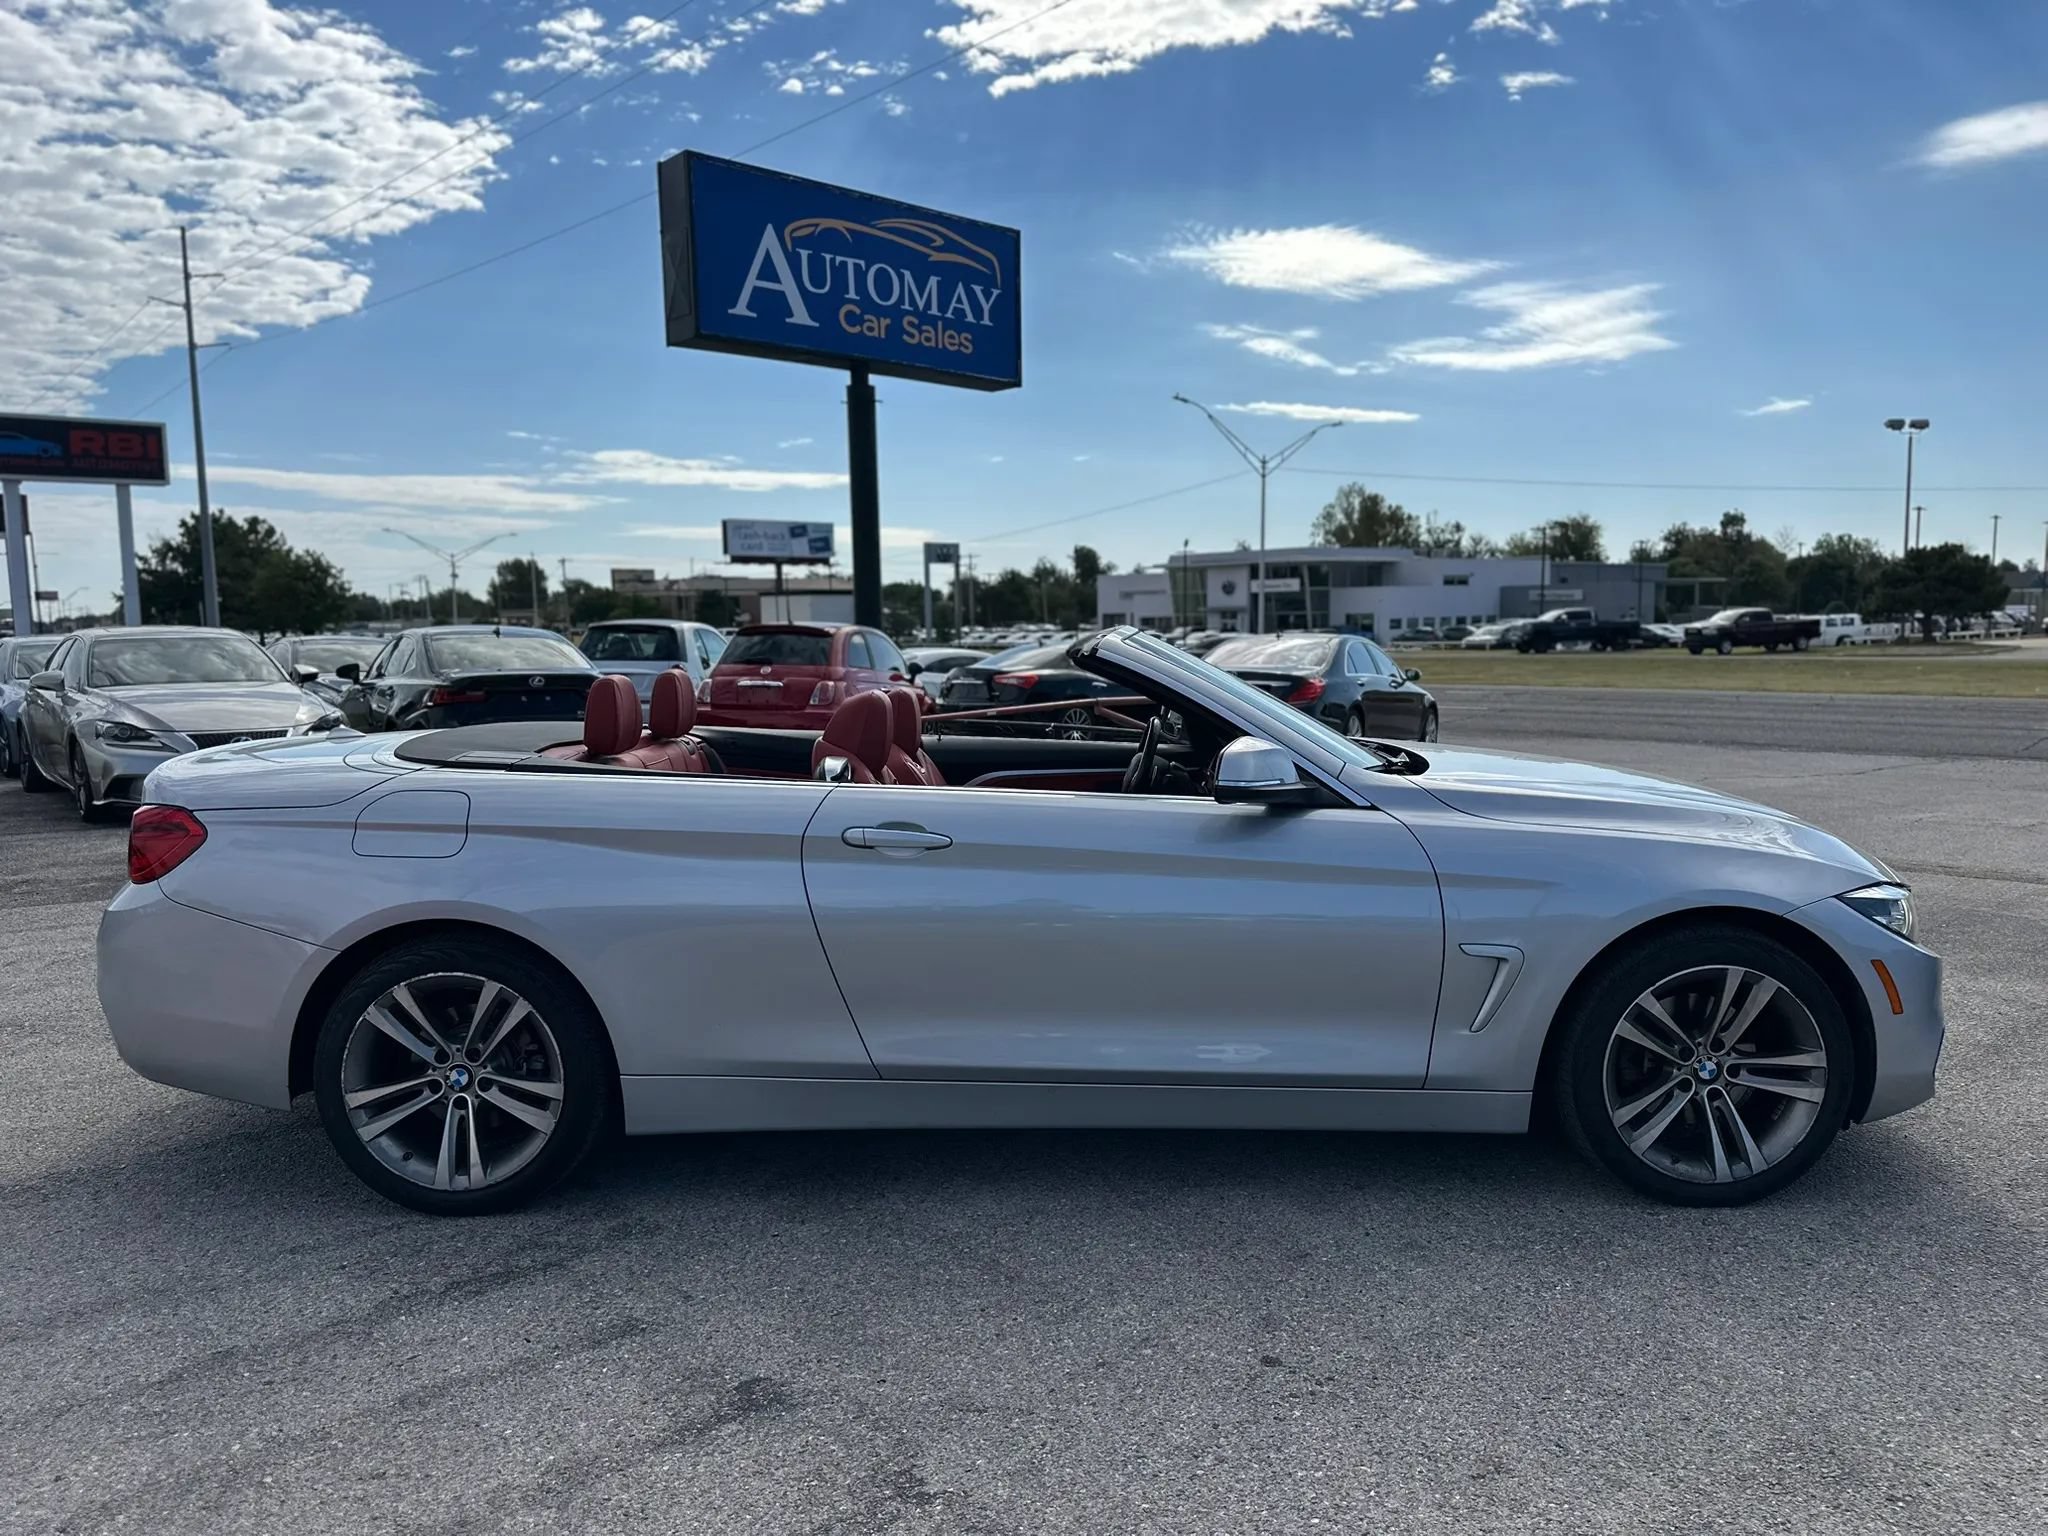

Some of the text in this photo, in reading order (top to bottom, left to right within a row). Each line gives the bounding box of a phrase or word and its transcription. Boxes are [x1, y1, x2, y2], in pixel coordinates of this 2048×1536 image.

[727, 222, 1002, 328] AUTOMAY
[838, 304, 973, 354] Car Sales
[69, 429, 160, 460] RBI
